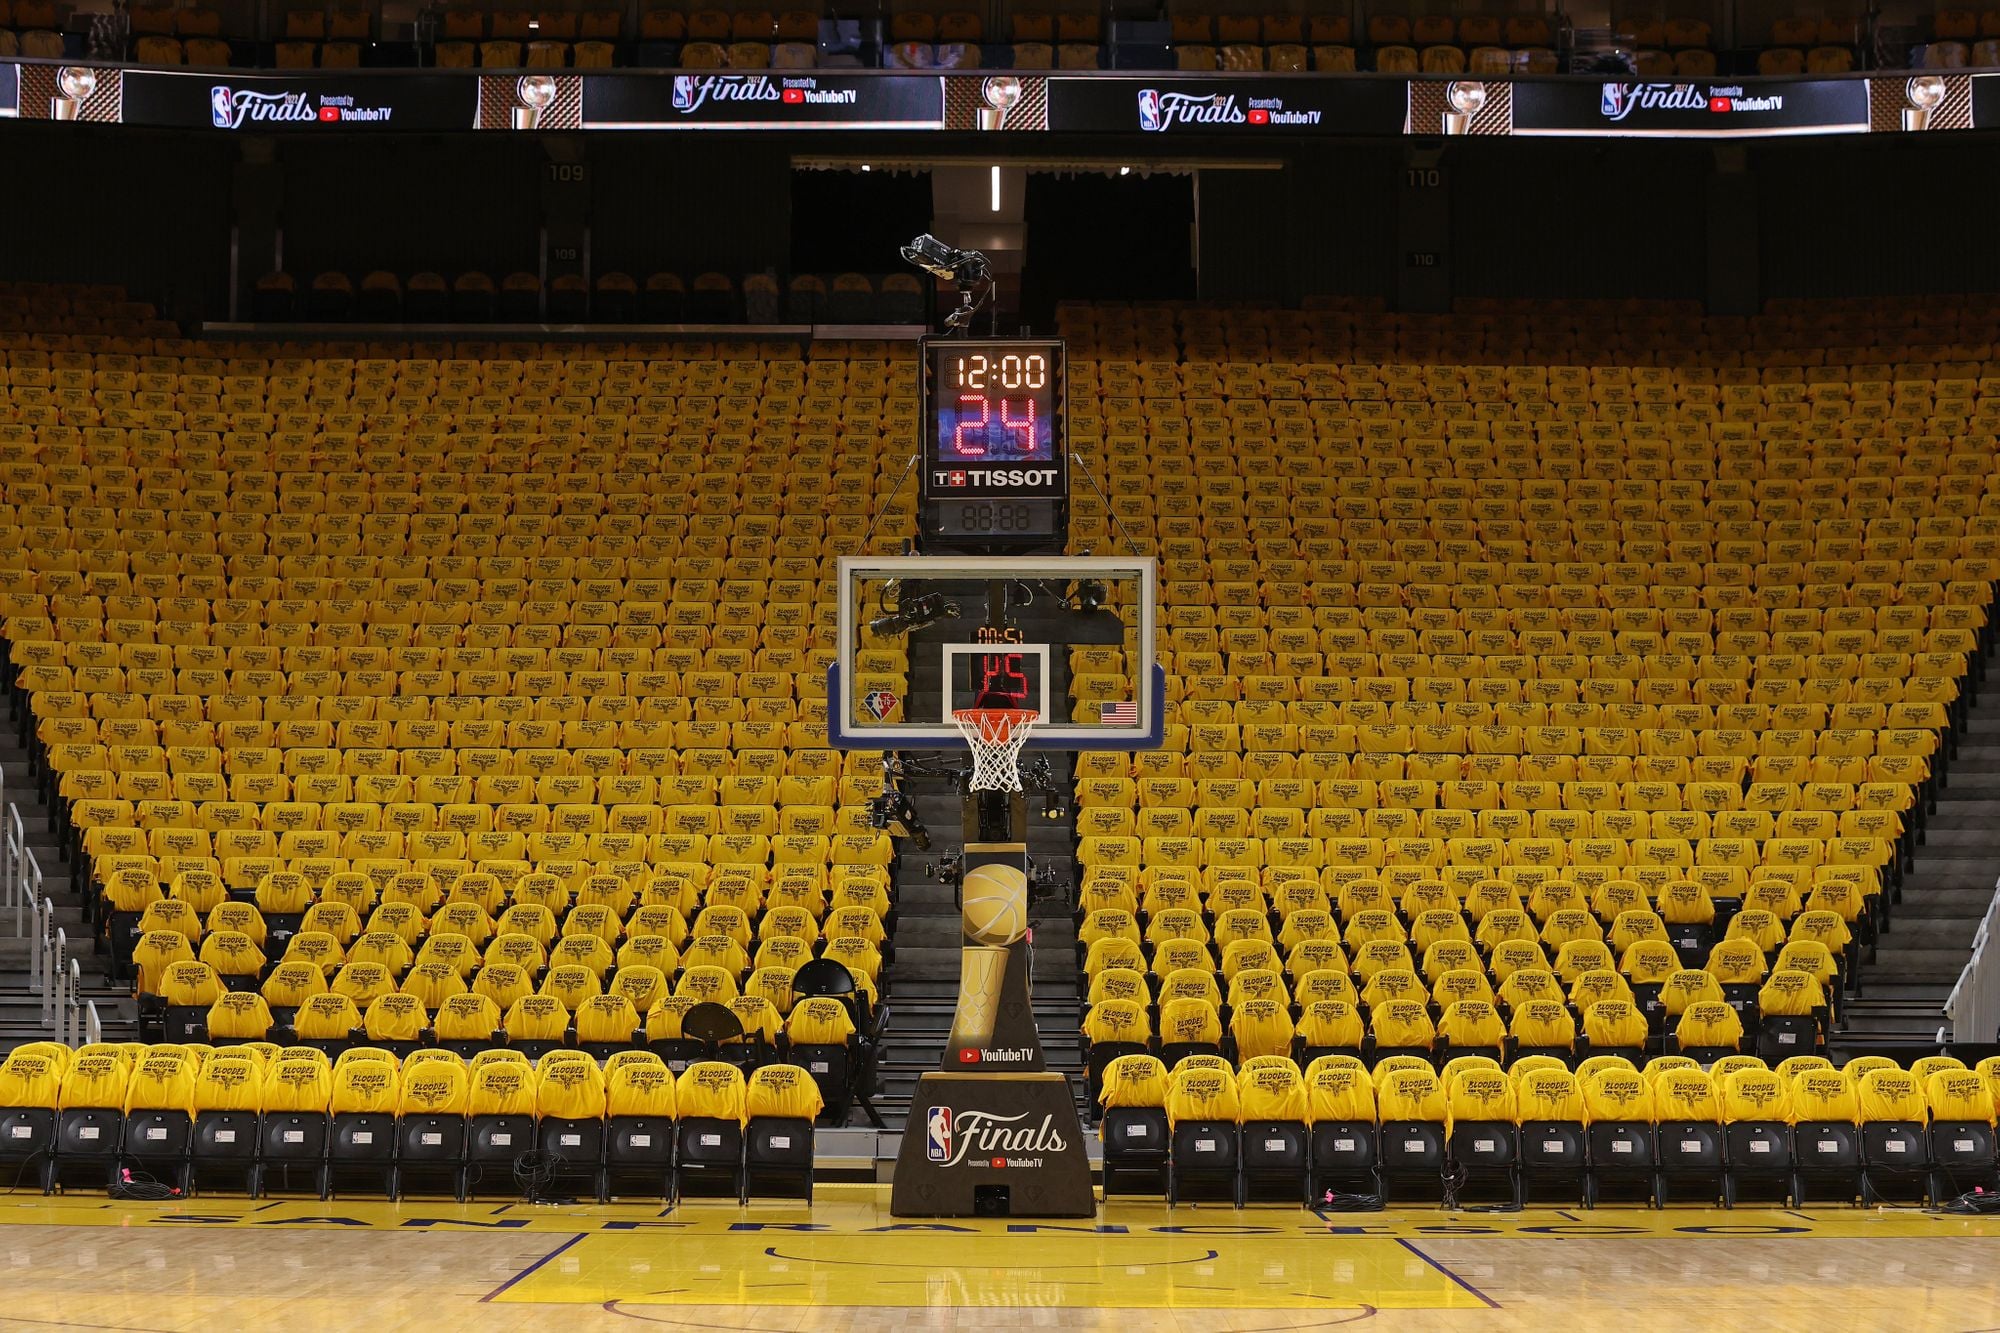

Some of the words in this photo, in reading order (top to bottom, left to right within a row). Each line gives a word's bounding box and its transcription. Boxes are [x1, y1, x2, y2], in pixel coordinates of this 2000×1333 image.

[783, 77, 808, 88] Presented
[809, 78, 816, 89] by
[1710, 86, 1735, 96] Presented
[1736, 86, 1743, 97] by
[320, 95, 346, 105] Presented
[346, 95, 354, 106] by
[1249, 97, 1275, 108] Presented
[1276, 98, 1282, 110] by
[231, 90, 318, 129] Finals
[1158, 92, 1246, 132] Finals
[550, 164, 584, 182] 109
[1408, 170, 1440, 187] 110
[554, 249, 576, 260] 109
[1414, 254, 1433, 266] 110
[958, 355, 1045, 388] 12:00
[956, 395, 1035, 454] 24
[968, 470, 1058, 486] TISSOT
[884, 696, 891, 706] 75
[272, 874, 301, 882] BLOODED
[589, 877, 619, 886] BLOODED
[1221, 887, 1252, 896] BLOODED
[1669, 885, 1699, 893] BLOODED
[154, 902, 185, 910] BLOODED
[220, 910, 250, 918] BLOODED
[448, 909, 479, 917] BLOODED
[1555, 912, 1585, 921] BLOODED
[707, 914, 739, 922] BLOODED
[1096, 914, 1128, 922] BLOODED
[1229, 916, 1260, 925] BLOODED
[1740, 914, 1770, 922] BLOODED
[216, 935, 247, 944] BLOODED
[297, 939, 328, 948] BLOODED
[562, 939, 594, 947] BLOODED
[432, 940, 463, 949] BLOODED
[771, 941, 802, 949] BLOODED
[1369, 944, 1400, 953] BLOODED
[1167, 950, 1199, 958] BLOODED
[1570, 954, 1602, 962] BLOODED
[1639, 955, 1670, 963] BLOODED
[1789, 957, 1820, 965] BLOODED
[175, 967, 206, 975] BLOODED
[280, 970, 311, 978] BLOODED
[552, 971, 586, 980] BLOODED
[688, 975, 719, 984] BLOODED
[1445, 976, 1476, 985] BLOODED
[1516, 974, 1548, 983] BLOODED
[1772, 974, 1806, 983] BLOODED
[1175, 982, 1207, 991] BLOODED
[222, 993, 255, 1002] BLOODED
[311, 996, 345, 1005] BLOODED
[384, 996, 416, 1005] BLOODED
[523, 998, 555, 1007] BLOODED
[1312, 1002, 1345, 1011] BLOODED
[1458, 1002, 1490, 1011] BLOODED
[1594, 1002, 1628, 1011] BLOODED
[807, 1003, 840, 1012] BLOODED
[1391, 1004, 1422, 1012] BLOODED
[1692, 1005, 1726, 1014] BLOODED
[281, 1050, 315, 1058] BLOODED
[11, 1060, 47, 1068] BLOODED
[78, 1058, 113, 1067] BLOODED
[143, 1059, 178, 1068] BLOODED
[1121, 1062, 1152, 1071] BLOODED
[1186, 1058, 1220, 1067] BLOODED
[1326, 1062, 1359, 1070] BLOODED
[212, 1066, 247, 1075] BLOODED
[281, 1066, 315, 1075] BLOODED
[550, 1066, 585, 1075] BLOODED
[631, 1070, 665, 1080] BLOODED
[699, 1069, 733, 1078] BLOODED
[760, 1070, 795, 1079] BLOODED
[352, 1074, 386, 1083] BLOODED
[486, 1075, 520, 1083] BLOODED
[1257, 1071, 1292, 1080] BLOODED
[1316, 1072, 1352, 1081] BLOODED
[413, 1082, 448, 1091] BLOODED
[1186, 1079, 1221, 1089] BLOODED
[1399, 1079, 1433, 1089] BLOODED
[1467, 1080, 1502, 1089] BLOODED
[1535, 1081, 1569, 1089] BLOODED
[1603, 1081, 1638, 1090] BLOODED
[1673, 1082, 1708, 1091] BLOODED
[1807, 1079, 1842, 1088] BLOODED
[1876, 1080, 1911, 1089] BLOODED
[1947, 1077, 1980, 1088] BLOODED
[1741, 1083, 1776, 1092] BLOODED
[939, 1110, 1068, 1168] Finals
[930, 1148, 943, 1158] NBA
[148, 1215, 532, 1228] SAN
